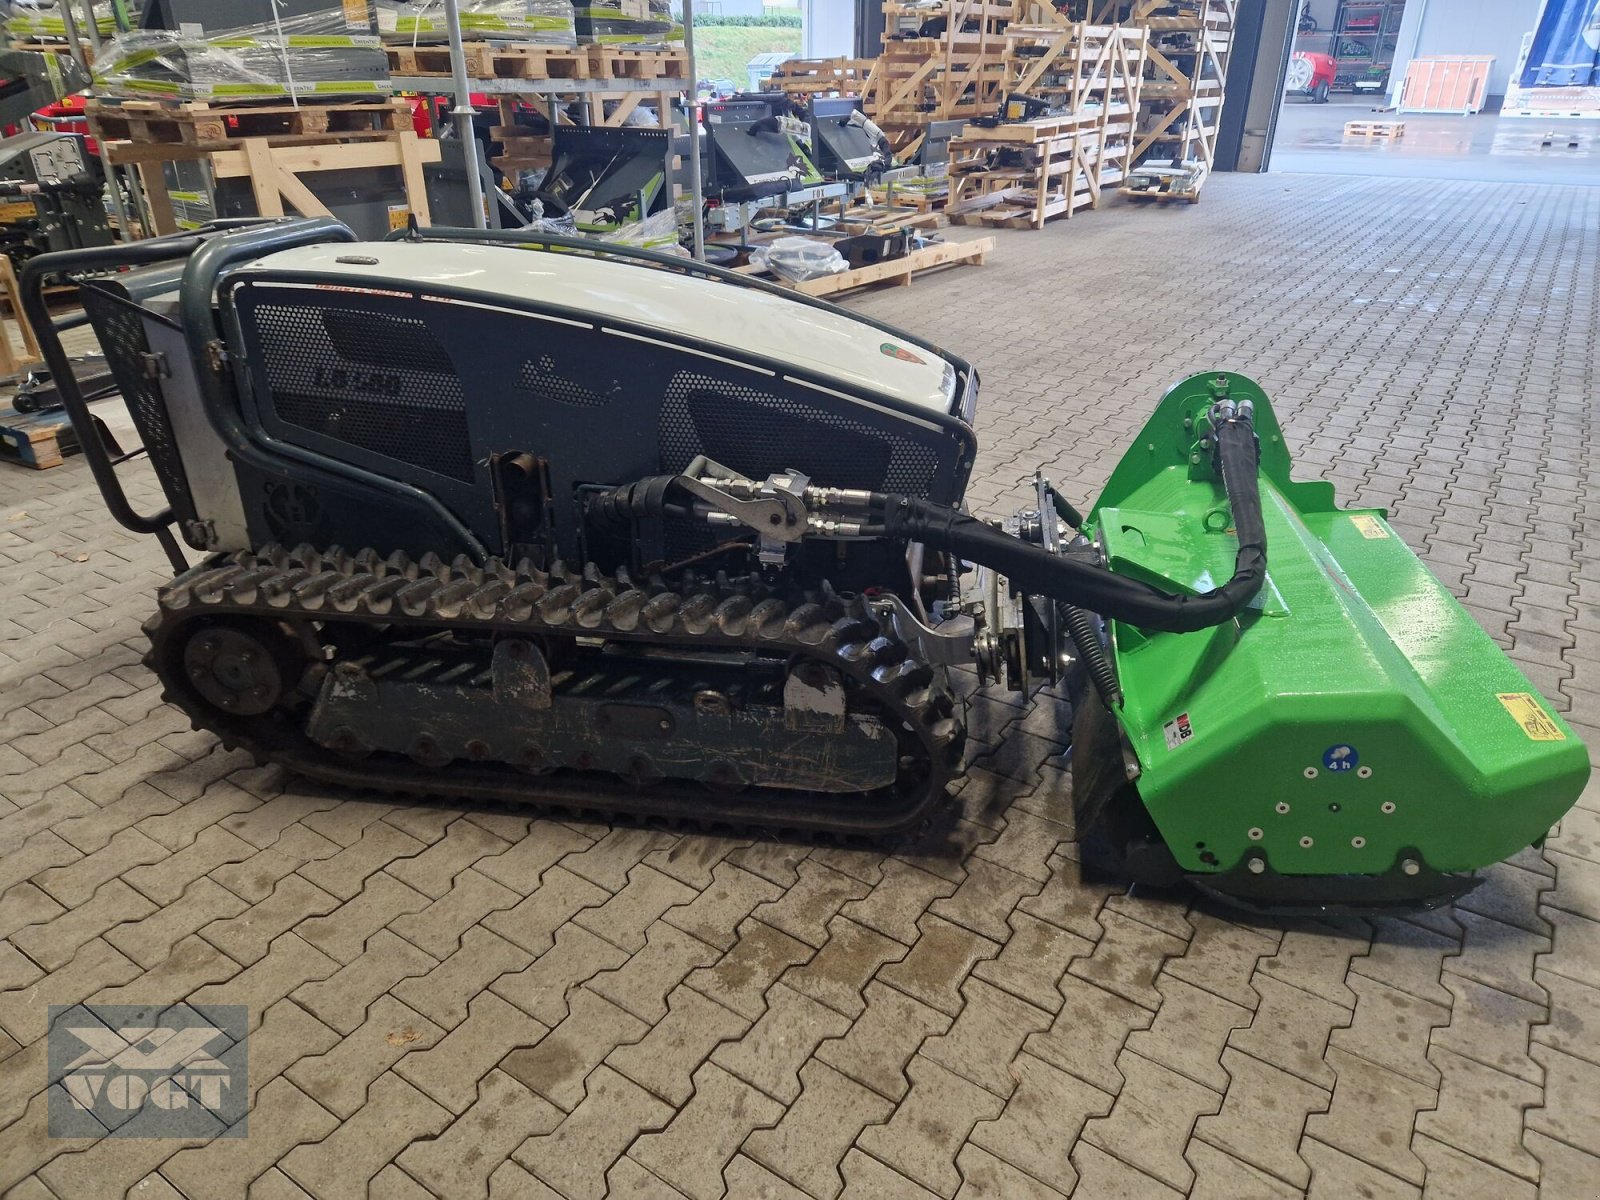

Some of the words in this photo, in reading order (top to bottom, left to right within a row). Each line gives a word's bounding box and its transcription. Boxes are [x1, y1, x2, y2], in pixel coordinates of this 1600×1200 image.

[812, 189, 825, 199] FOX
[1177, 712, 1192, 739] MDB
[1328, 761, 1338, 770] 4
[1342, 760, 1351, 770] h
